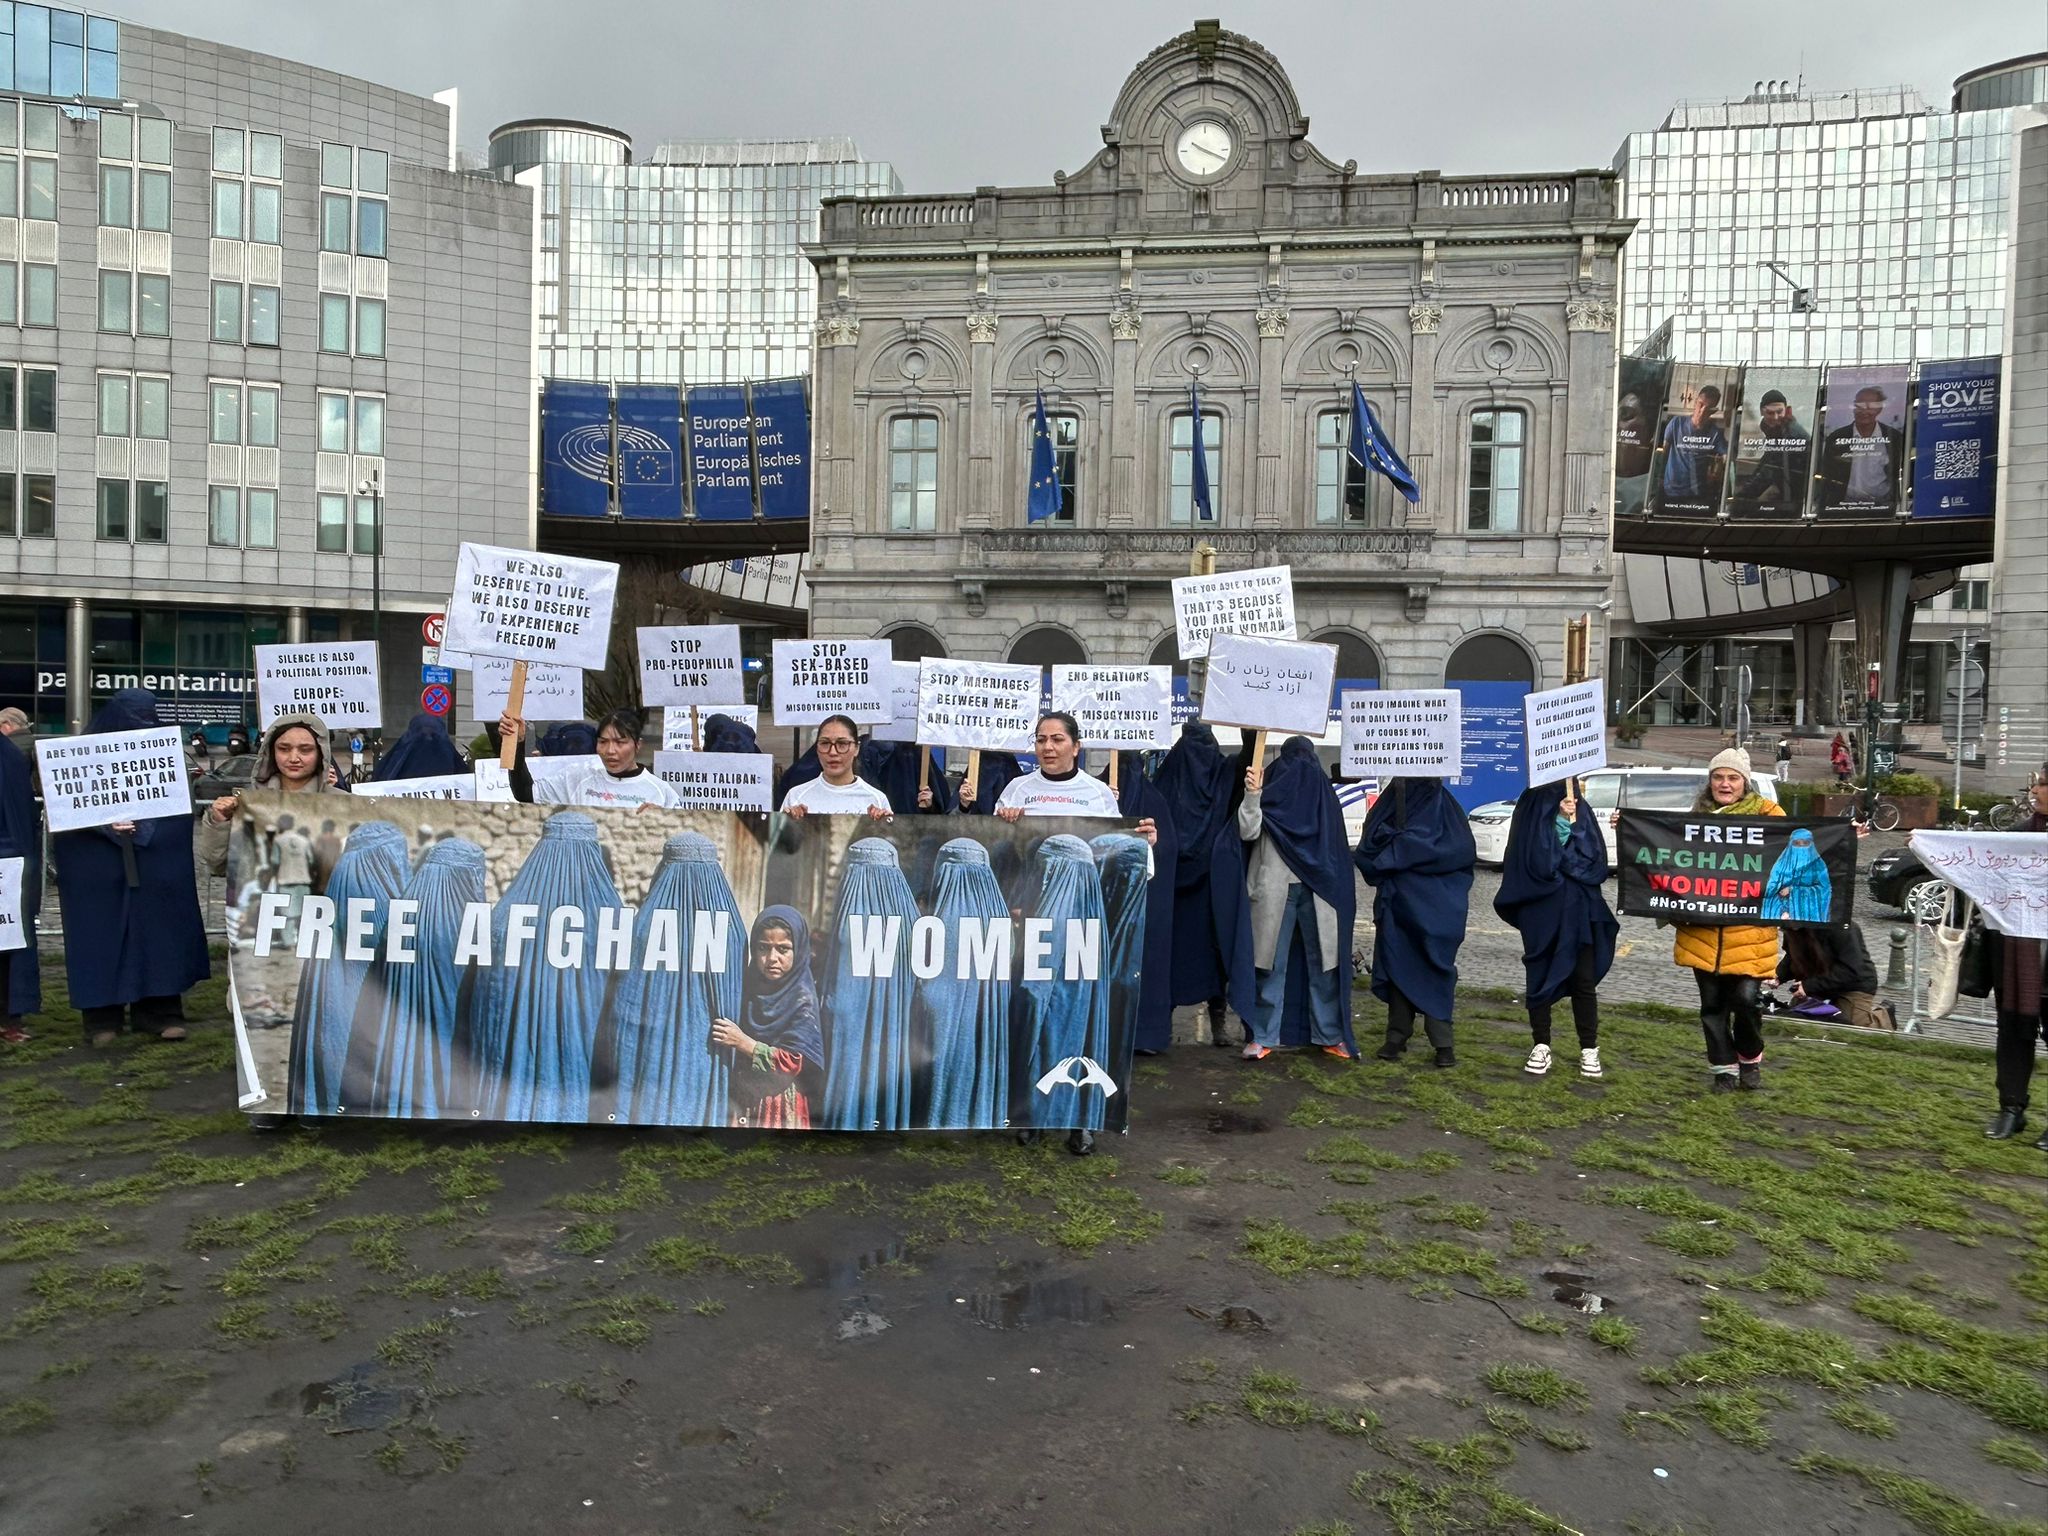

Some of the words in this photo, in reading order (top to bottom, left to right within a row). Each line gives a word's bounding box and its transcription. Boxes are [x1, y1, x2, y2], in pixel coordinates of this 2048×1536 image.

[1928, 381, 1962, 391] SHOW
[1965, 378, 1995, 388] YOUR
[1928, 388, 1995, 409] LOVE
[693, 416, 772, 431] European
[694, 432, 783, 448] Parliament
[1682, 435, 1711, 444] CHRISTY
[1744, 438, 1763, 446] LOVE
[1765, 438, 1776, 446] ME
[1777, 438, 1807, 446] TENDER
[1835, 436, 1891, 445] SENTIMENTAL
[696, 452, 801, 471] Europäisches
[697, 472, 783, 487] Parlament
[506, 560, 525, 574] WE
[530, 564, 563, 579] ALSO
[473, 574, 531, 593] DESERVE
[536, 582, 551, 596] TO
[557, 585, 589, 601] LIVE.
[471, 591, 490, 605] WE
[496, 594, 529, 610] ALSO
[534, 600, 591, 618] DESERVE
[1182, 600, 1224, 615] THAT'S
[1229, 592, 1282, 610] BECAUSE
[479, 610, 495, 624] TO
[501, 613, 580, 635] EXPERIENCE
[1184, 615, 1207, 628] YOU
[1212, 612, 1234, 625] ARE
[1240, 608, 1262, 622] NOT
[1268, 606, 1283, 619] AN
[1239, 619, 1286, 635] WOMAN
[496, 630, 557, 650] FREEDOM
[670, 640, 702, 654] STOP
[278, 654, 316, 664] SILENCE
[319, 652, 328, 662] IS
[332, 652, 355, 662] ALSO
[812, 644, 847, 657] STOP
[266, 669, 272, 678] A
[276, 667, 322, 678] POLITICAL
[326, 666, 372, 676] POSITION.
[646, 658, 734, 671] PRO-PEDOPHILIA
[792, 658, 869, 672] SEX-BASED
[673, 673, 708, 687] LAWS
[792, 672, 869, 686] APARTHEID
[930, 674, 958, 686] STOP
[964, 675, 1030, 691] MARRIAGES
[294, 686, 344, 700] EUROPE:
[816, 690, 848, 698] ENOUGH
[1096, 690, 1121, 701] with
[274, 703, 316, 716] SHAME
[321, 702, 336, 714] ON
[342, 701, 370, 714] YOU.
[845, 702, 880, 711] POLICIES
[937, 693, 988, 708] BETWEEN
[994, 698, 1018, 710] MEN
[1350, 700, 1366, 710] CAN
[1369, 700, 1384, 710] YOU
[1386, 700, 1421, 708] IMAGINE
[1424, 699, 1447, 708] WHAT
[927, 712, 949, 724] AND
[954, 714, 991, 728] LITTLE
[996, 718, 1029, 730] GIRLS
[1368, 714, 1391, 723] DAILY
[1394, 714, 1411, 722] LIFE
[1414, 714, 1422, 722] IS
[1425, 714, 1448, 722] LIKE?
[1114, 730, 1155, 740] REGIME
[1378, 728, 1408, 737] COURSE
[46, 748, 66, 760] ARE
[70, 746, 90, 757] YOU
[95, 744, 120, 754] ABLE
[124, 742, 136, 751] TO
[140, 738, 177, 749] STUDY?
[1353, 742, 1379, 751] WHICH
[1422, 742, 1444, 750] YOUR
[52, 764, 104, 782] THAT'S
[111, 756, 175, 774] BECAUSE
[54, 781, 84, 796] YOU
[91, 778, 118, 792] ARE
[124, 773, 152, 788] NOT
[158, 770, 176, 784] AN
[662, 771, 708, 783] REGIMEN
[72, 790, 130, 810] AFGHAN
[136, 786, 169, 801] GIRL
[442, 788, 461, 799] WE
[682, 786, 739, 799] MISOGINIA
[1684, 824, 1765, 845] FREE
[1635, 847, 1763, 873] AFGHAN
[1648, 873, 1762, 898] WOMEN
[1650, 896, 1758, 915] #NoToTaliban
[254, 893, 418, 964] FREE
[453, 902, 730, 974] AFGHAN
[848, 914, 1100, 981] WOMEN
